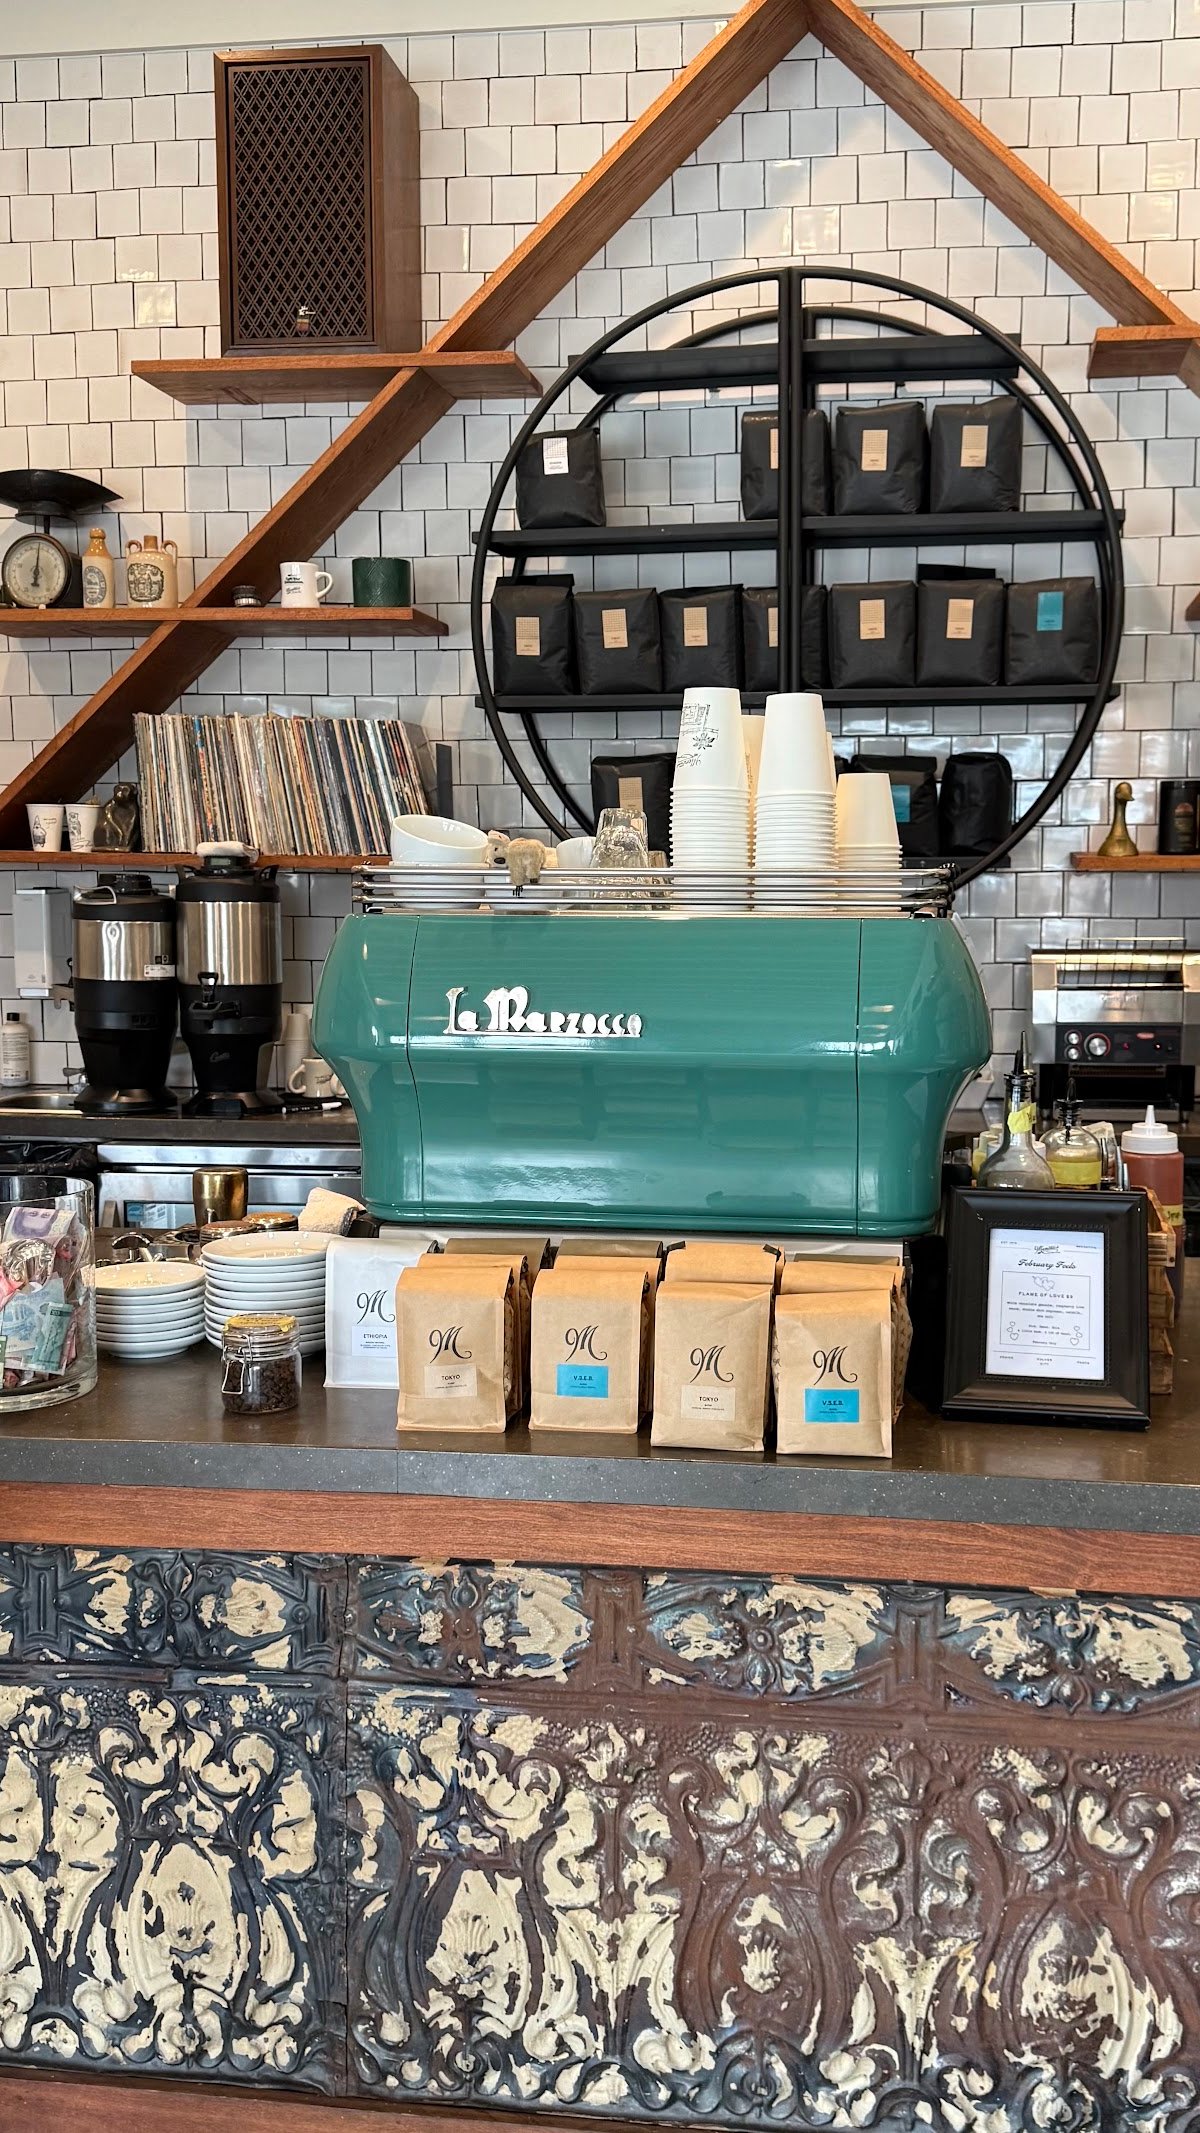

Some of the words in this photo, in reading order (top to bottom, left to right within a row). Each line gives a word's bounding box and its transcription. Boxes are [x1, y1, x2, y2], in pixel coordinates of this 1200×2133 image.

[443, 987, 479, 1034] La
[483, 985, 642, 1037] Marzocco
[1018, 1259, 1054, 1270] February
